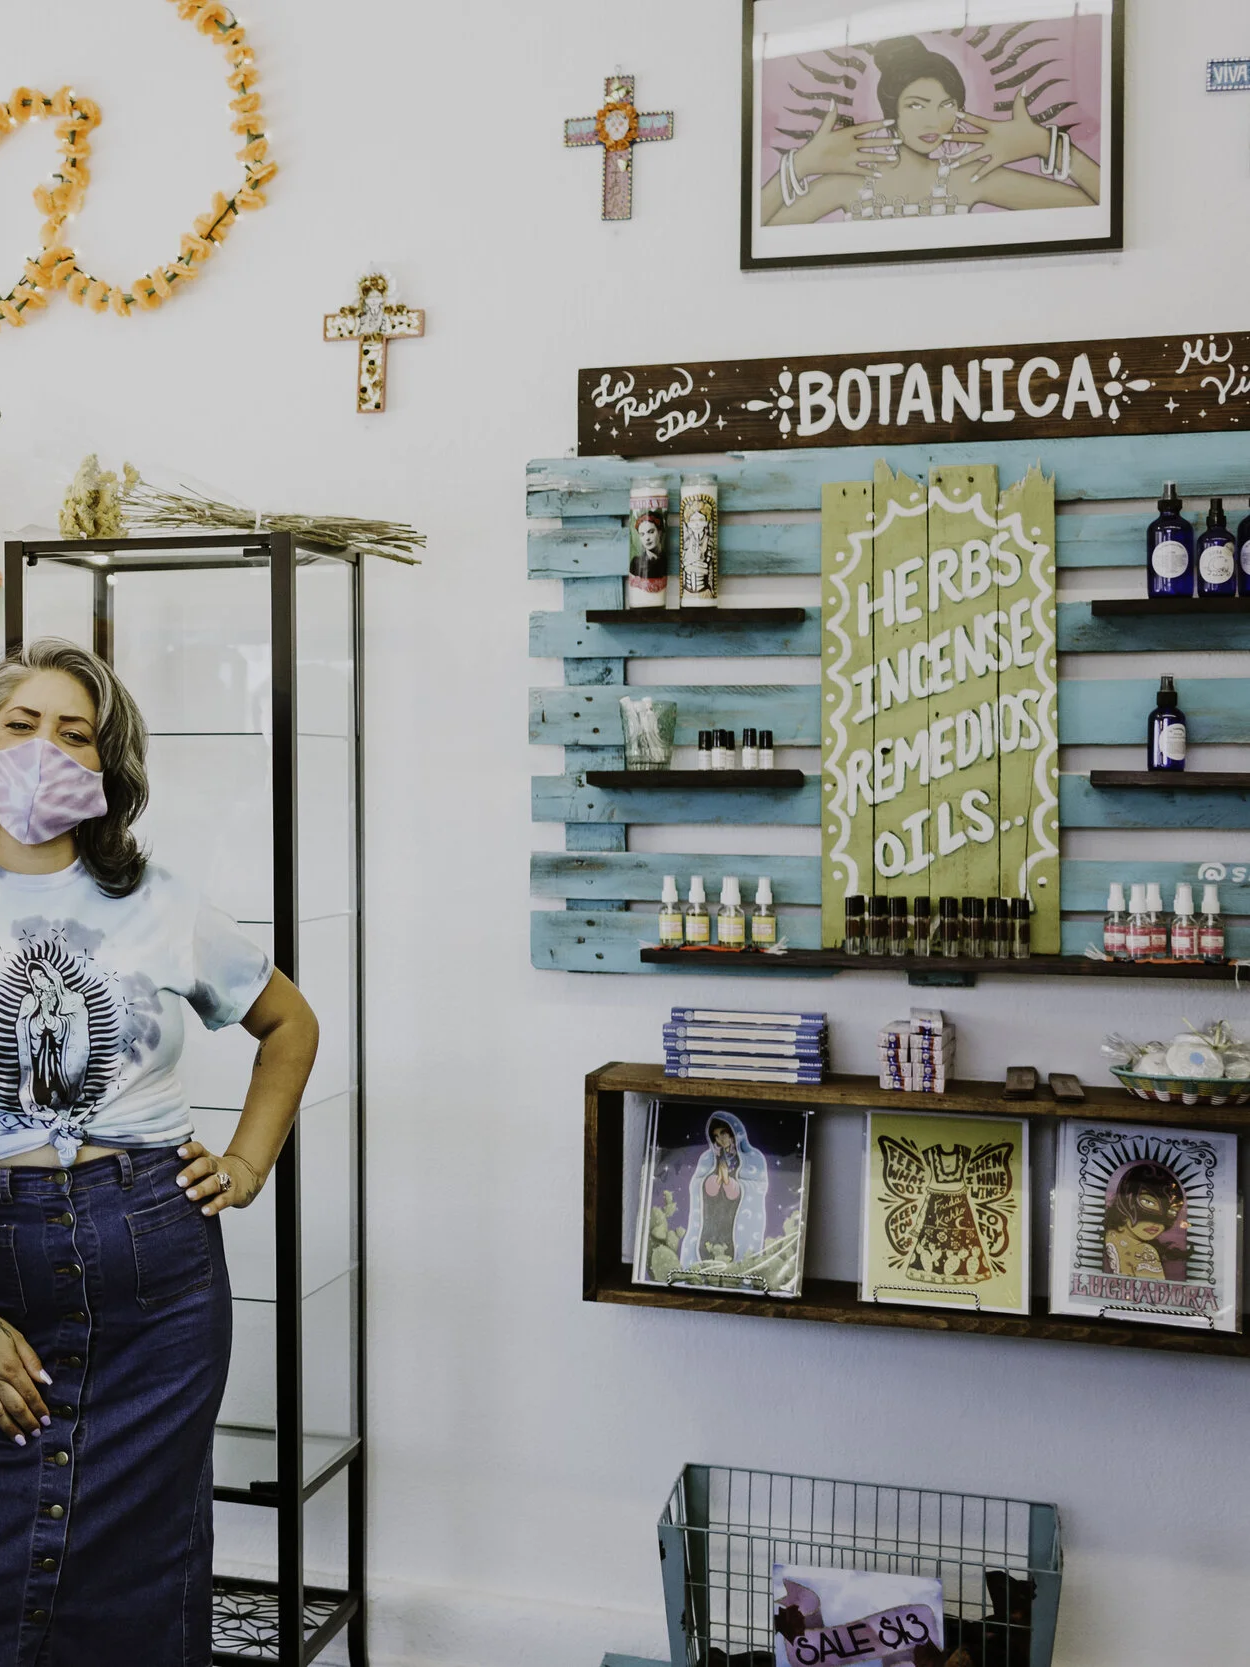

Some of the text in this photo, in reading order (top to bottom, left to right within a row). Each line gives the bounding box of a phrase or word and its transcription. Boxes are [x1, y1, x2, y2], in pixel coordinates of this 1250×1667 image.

[591, 371, 635, 408] La
[615, 367, 693, 427] Reina
[796, 353, 1103, 436] BOTANICA
[654, 399, 711, 442] De
[857, 531, 1022, 637] HERBS
[851, 598, 1036, 725] INCENSE
[846, 688, 1042, 817] REMEDIOS
[1197, 862, 1250, 883] @s
[967, 1150, 1003, 1175] WHEN
[892, 1182, 924, 1195] DO I
[966, 1171, 1007, 1187] I HAVE
[934, 1195, 963, 1214] Frida
[970, 1186, 1005, 1200] WINGS
[890, 1204, 918, 1226] NEED
[934, 1206, 967, 1228] Kahlo
[975, 1208, 999, 1226] TO
[891, 1218, 913, 1240] YOU
[977, 1221, 1003, 1244] FLY
[1069, 1273, 1220, 1312] LUCHADORA
[795, 1613, 930, 1666] SALE $13
